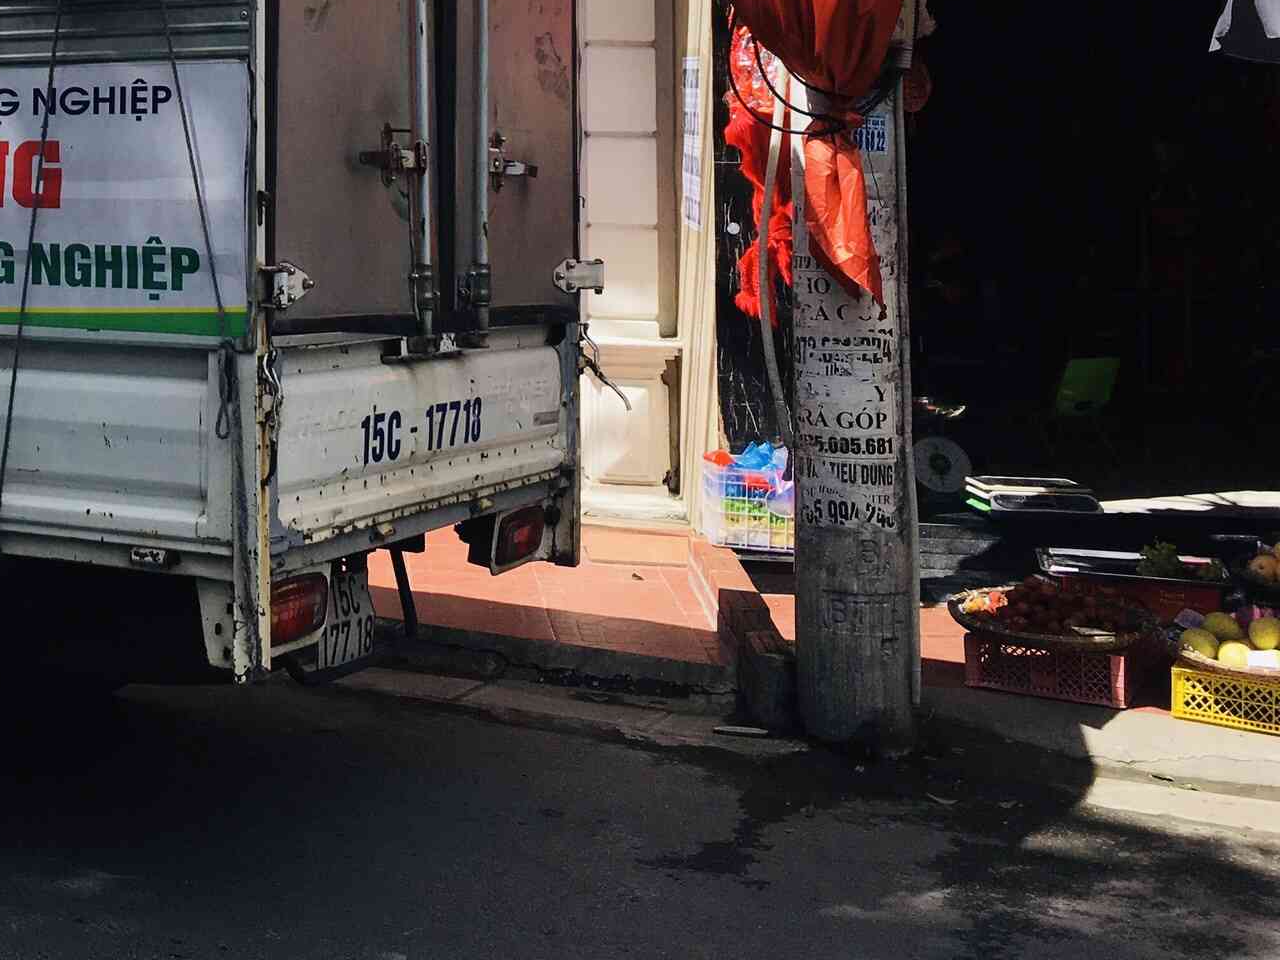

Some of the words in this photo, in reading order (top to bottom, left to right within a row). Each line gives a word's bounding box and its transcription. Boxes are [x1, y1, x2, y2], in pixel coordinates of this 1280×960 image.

[32, 78, 172, 122] NGHIỆP
[31, 236, 201, 301] NGHIỆP
[361, 410, 402, 465] 15C
[426, 396, 482, 451] 17718
[836, 407, 888, 429] GÓP
